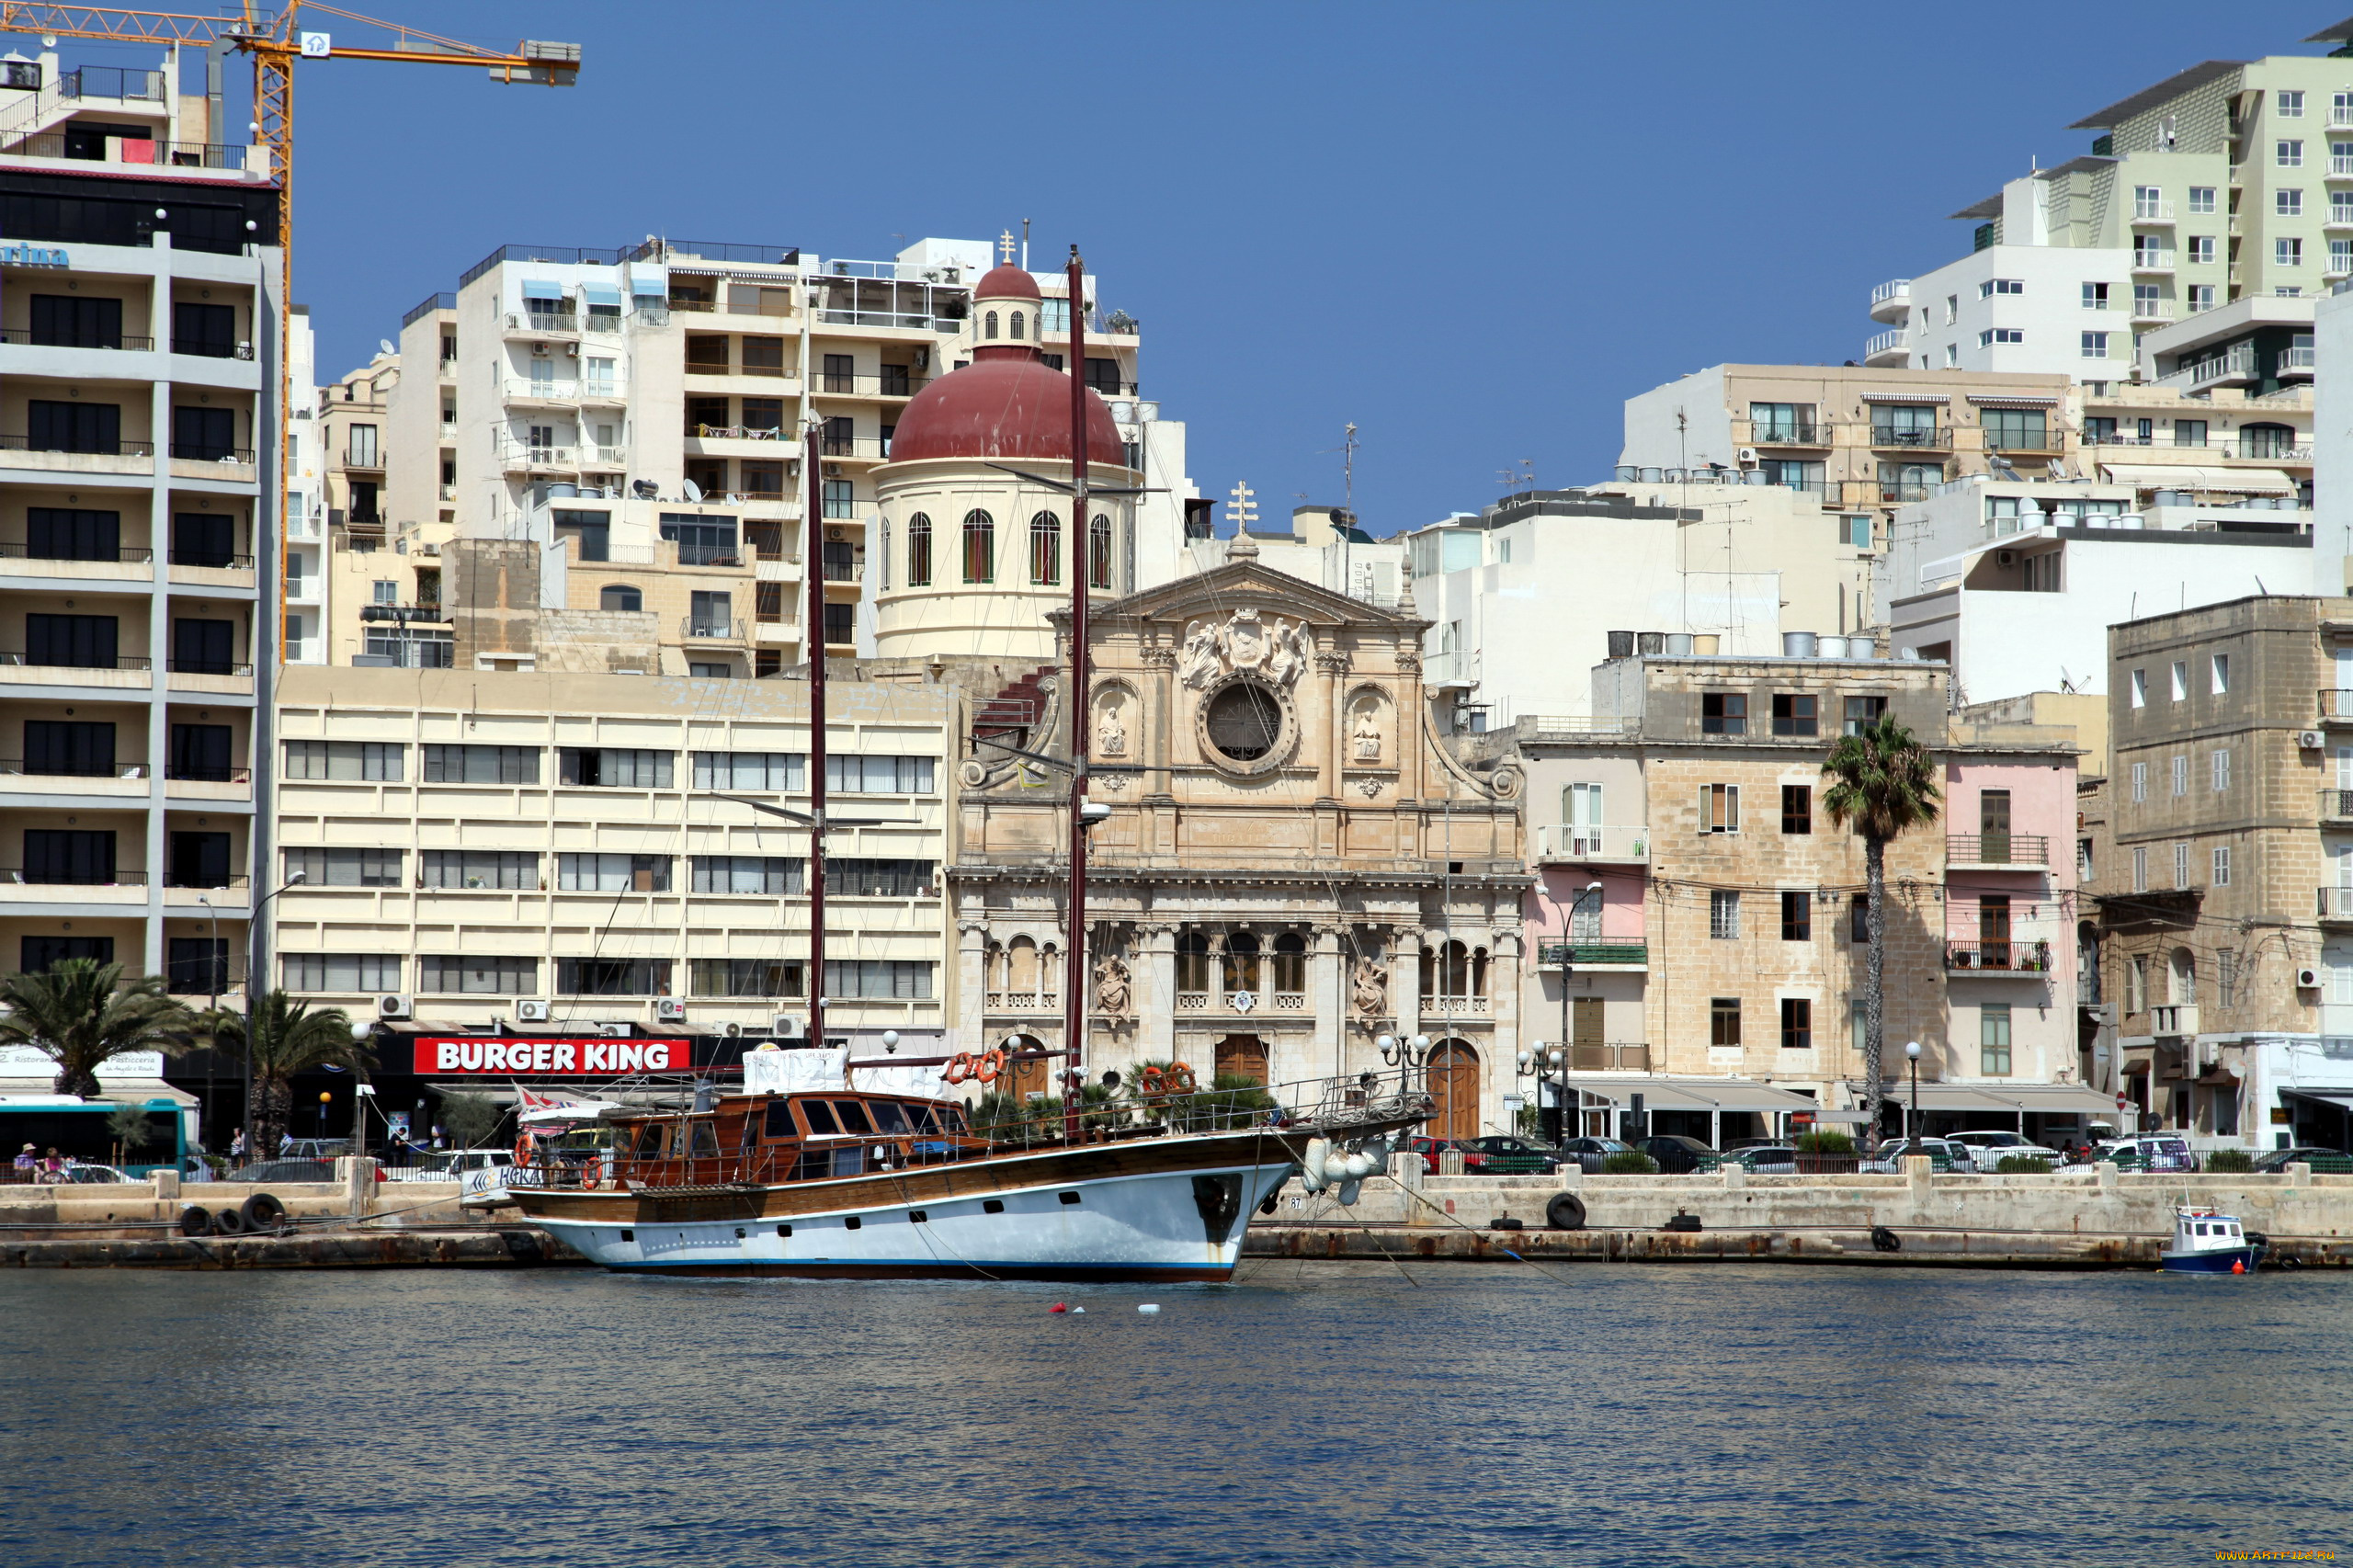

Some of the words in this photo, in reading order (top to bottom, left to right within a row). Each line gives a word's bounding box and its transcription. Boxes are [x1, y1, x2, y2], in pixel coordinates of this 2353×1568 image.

[0, 242, 69, 265] rina
[438, 1042, 575, 1071] BURGER
[585, 1043, 669, 1071] KING
[1290, 1198, 1302, 1209] 87
